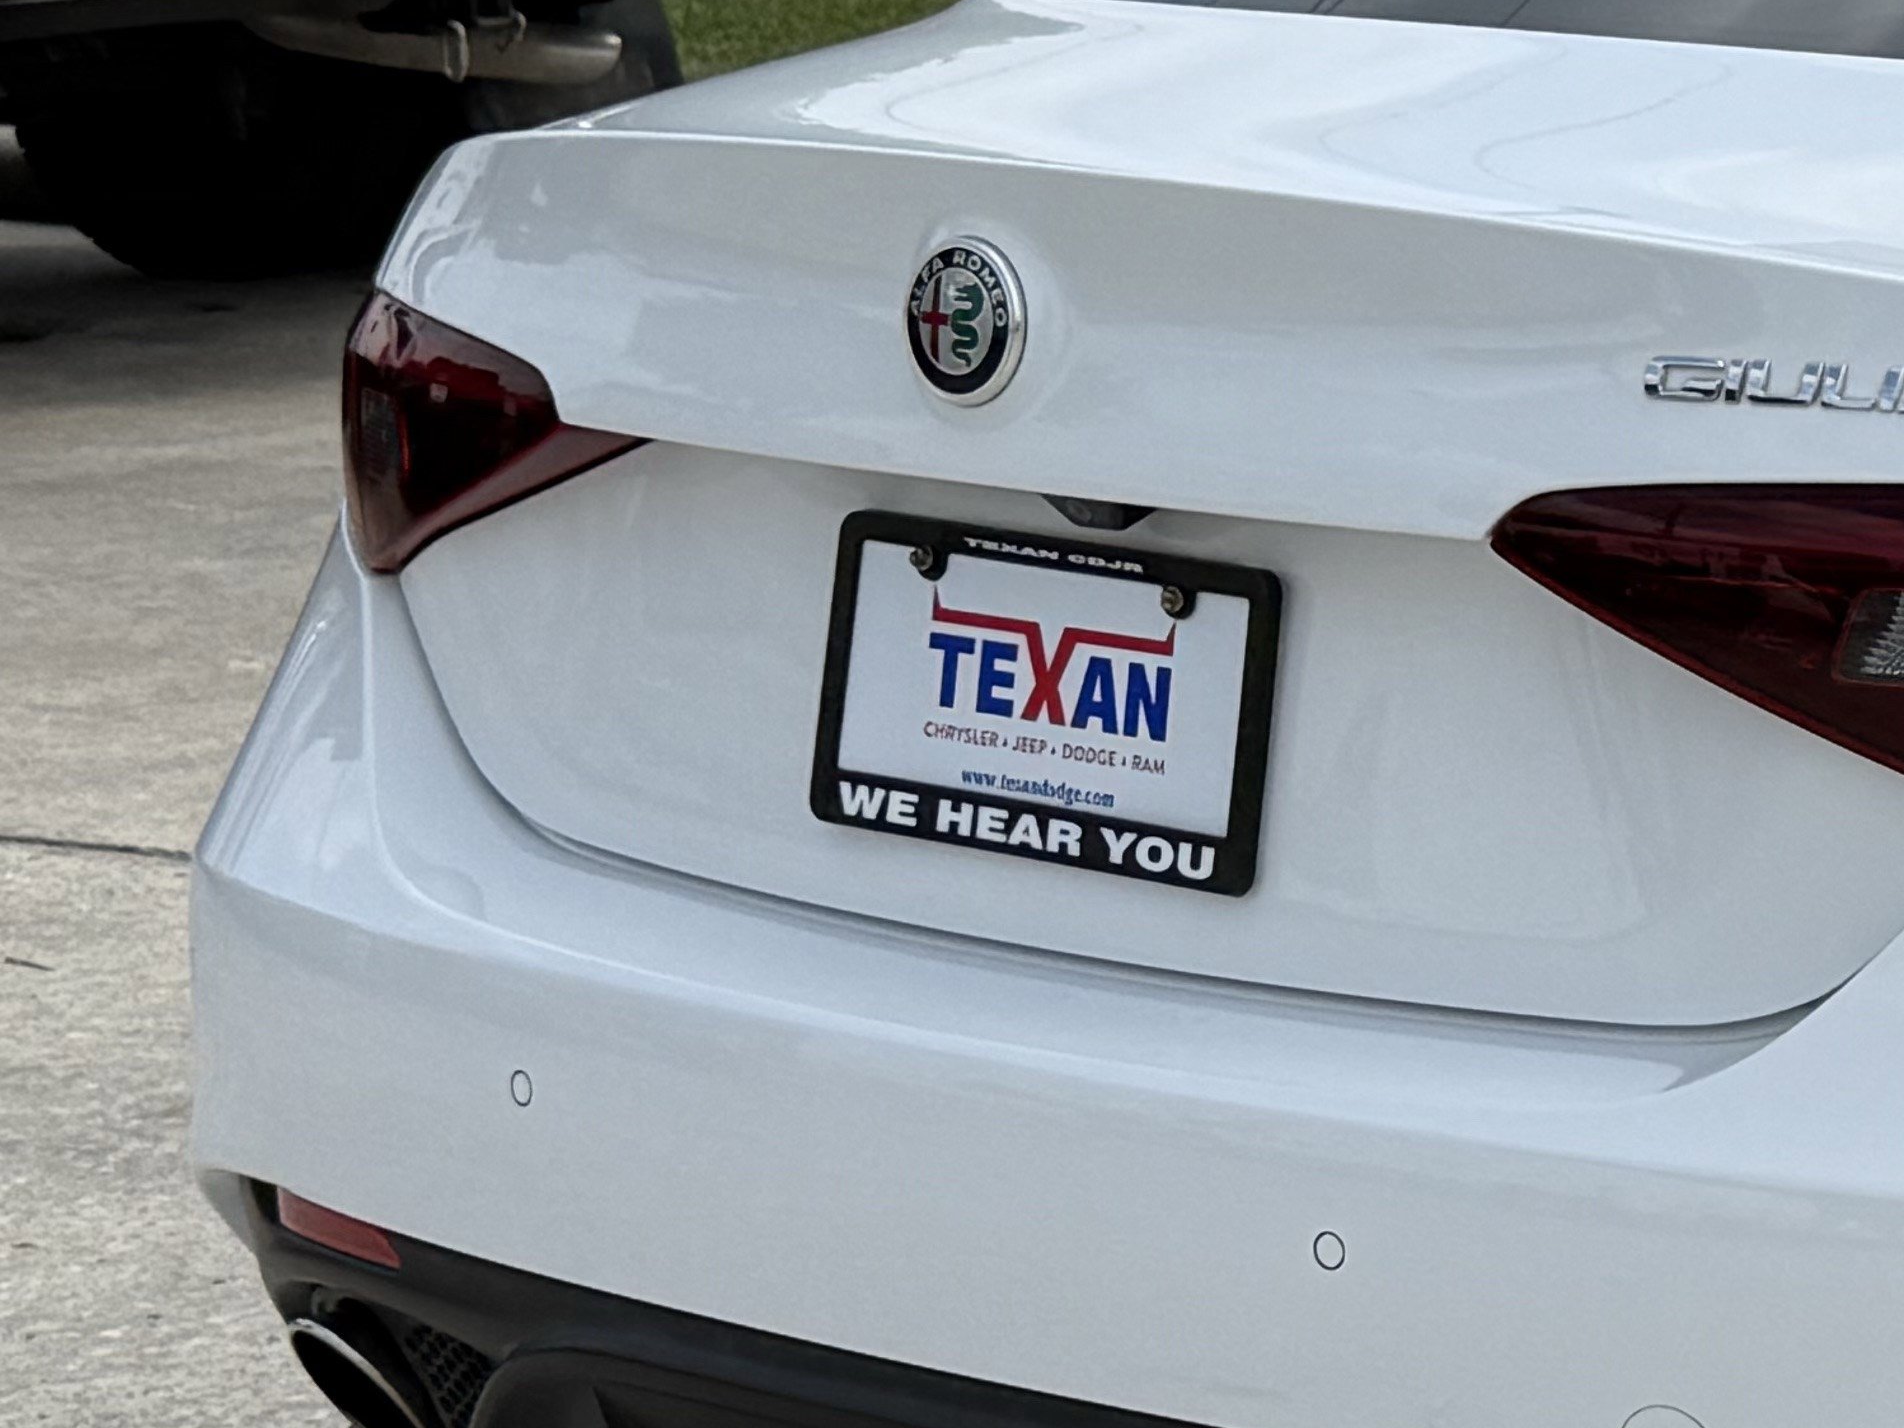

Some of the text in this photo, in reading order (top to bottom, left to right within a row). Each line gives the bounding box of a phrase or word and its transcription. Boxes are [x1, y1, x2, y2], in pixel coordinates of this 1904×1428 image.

[910, 249, 1008, 327] ALFA ROMEO
[963, 537, 1060, 560] TEXAN
[929, 607, 1174, 742] TEXAN
[923, 721, 1166, 775] CHRYSLER JEEP DODGE RAM
[838, 780, 1215, 881] WE HEAR YOU
